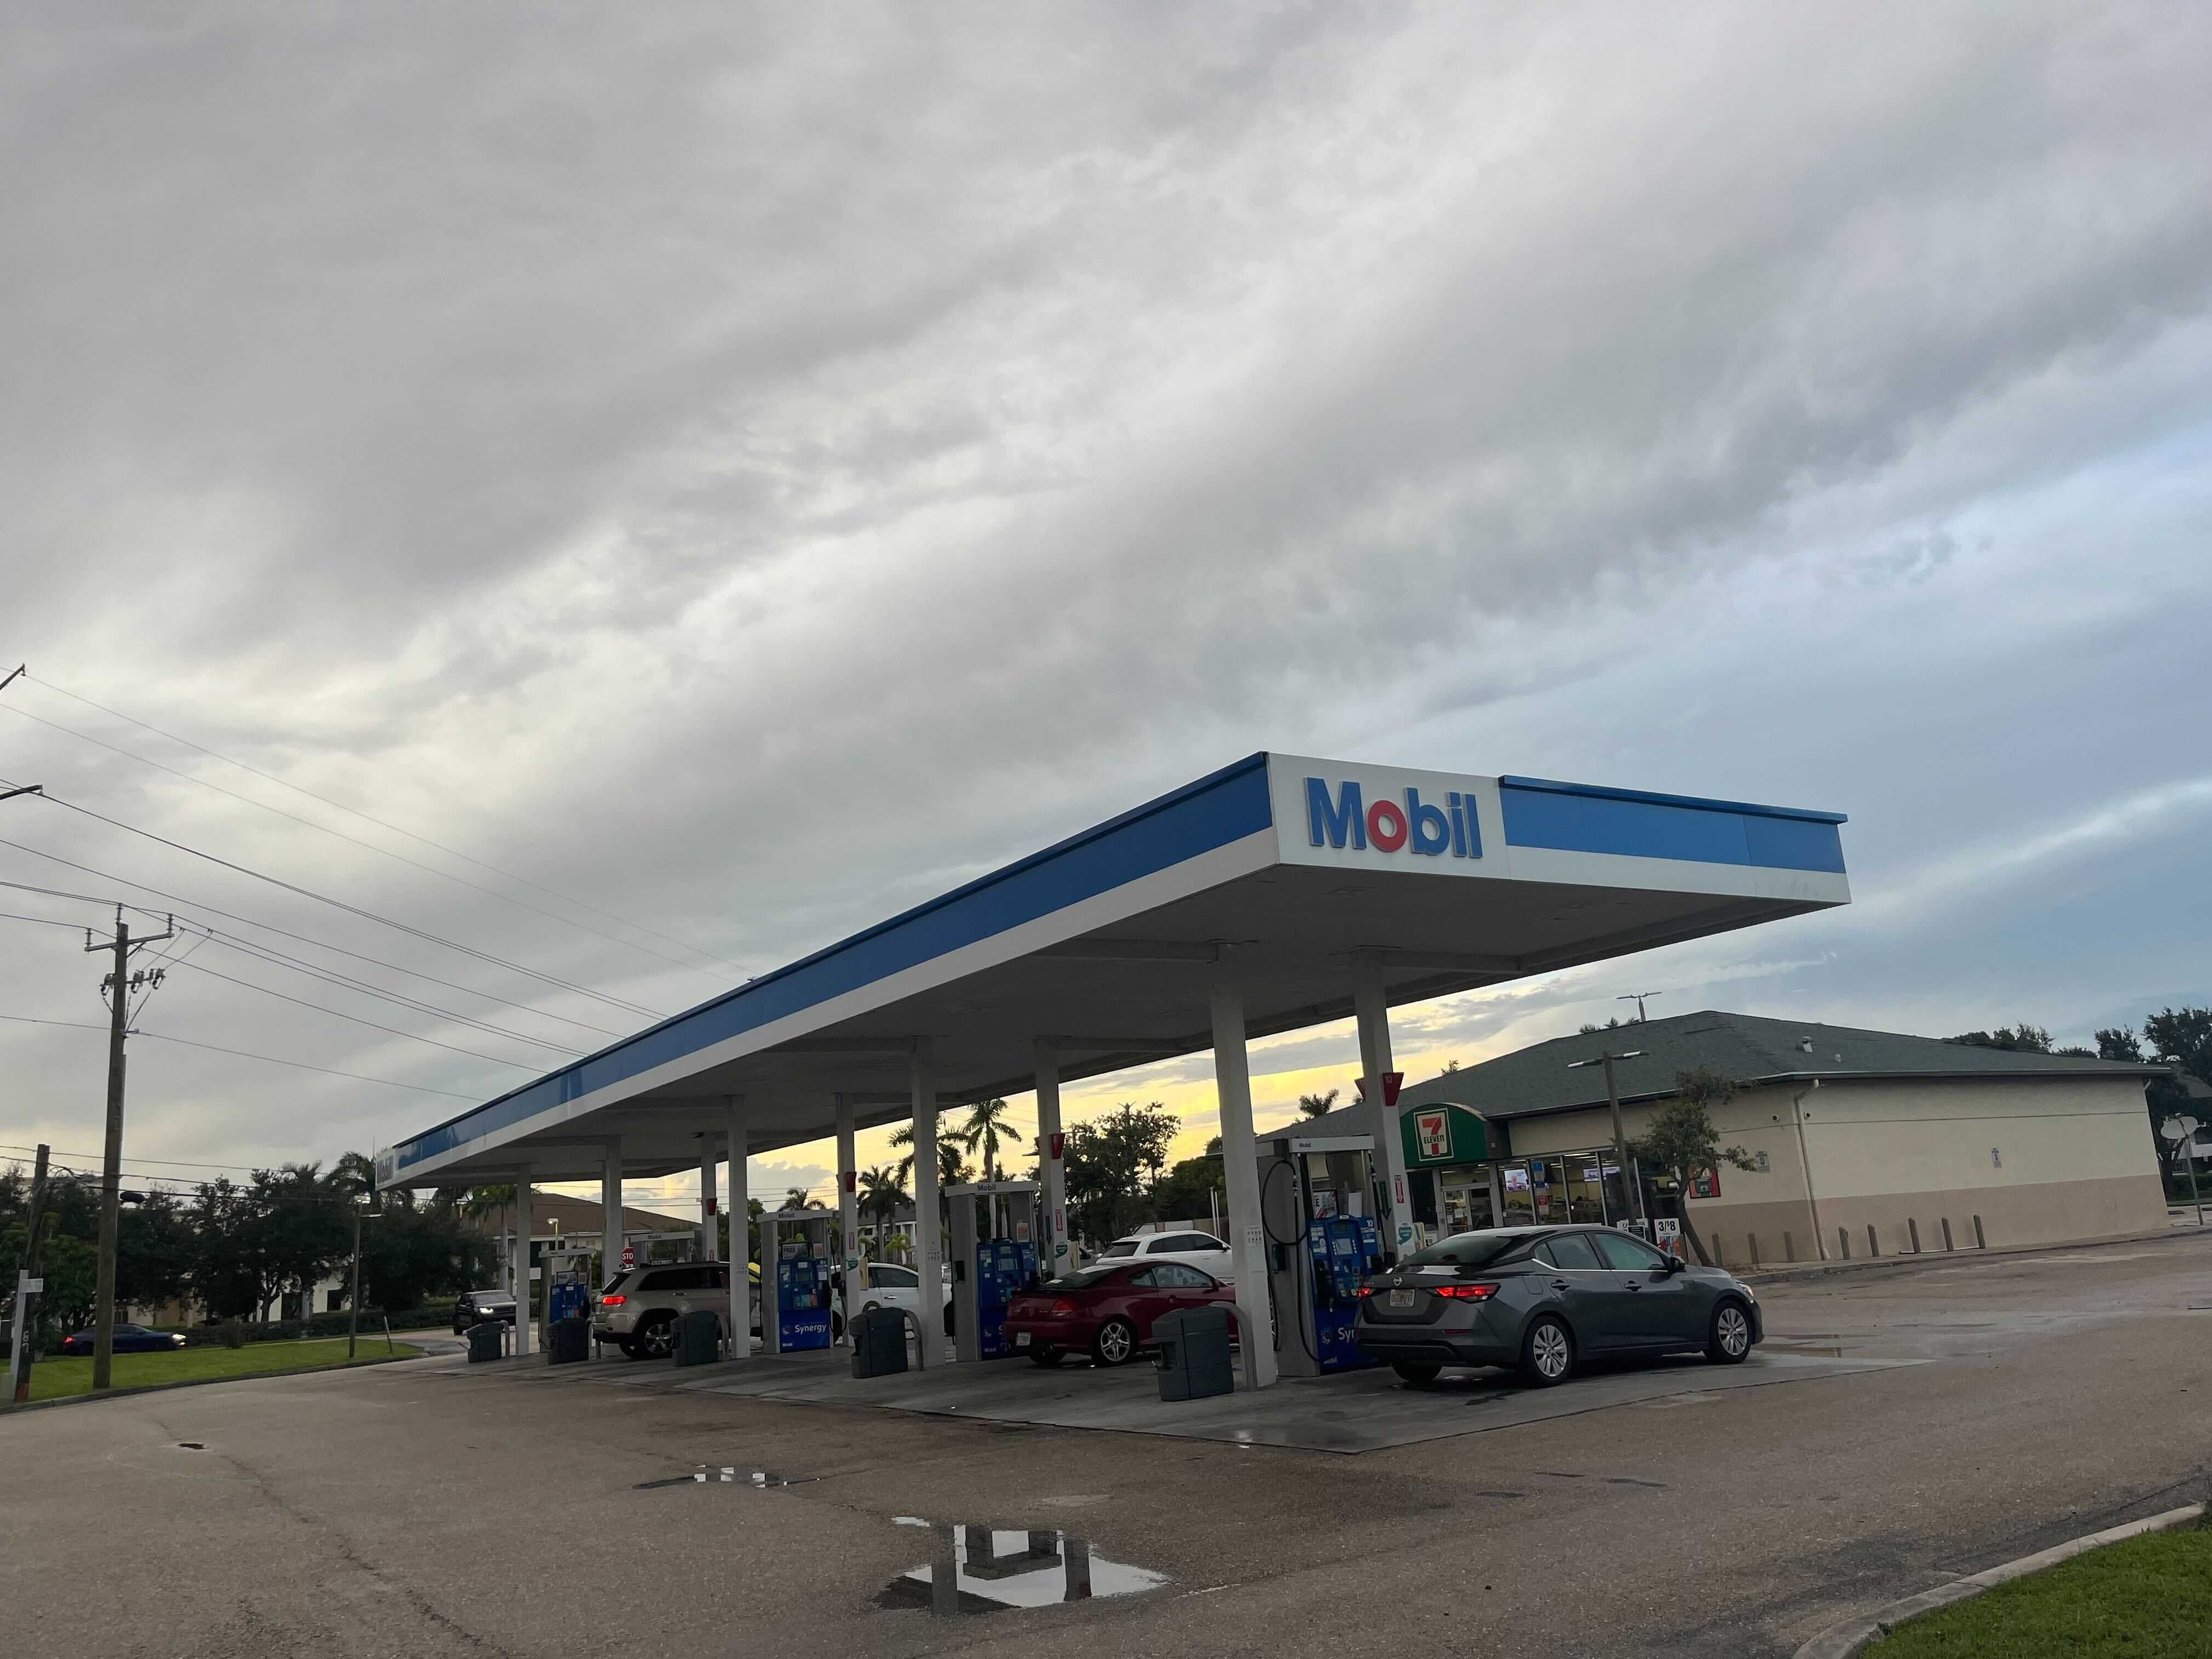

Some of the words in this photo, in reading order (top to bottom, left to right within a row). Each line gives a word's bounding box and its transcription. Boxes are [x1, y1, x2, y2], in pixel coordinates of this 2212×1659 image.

[1304, 777, 1483, 858] Mobil
[1384, 1075, 1392, 1084] 10
[1422, 1117, 1442, 1156] 7
[1658, 1221, 1676, 1232] 3/$8
[795, 1324, 827, 1335] Synergy
